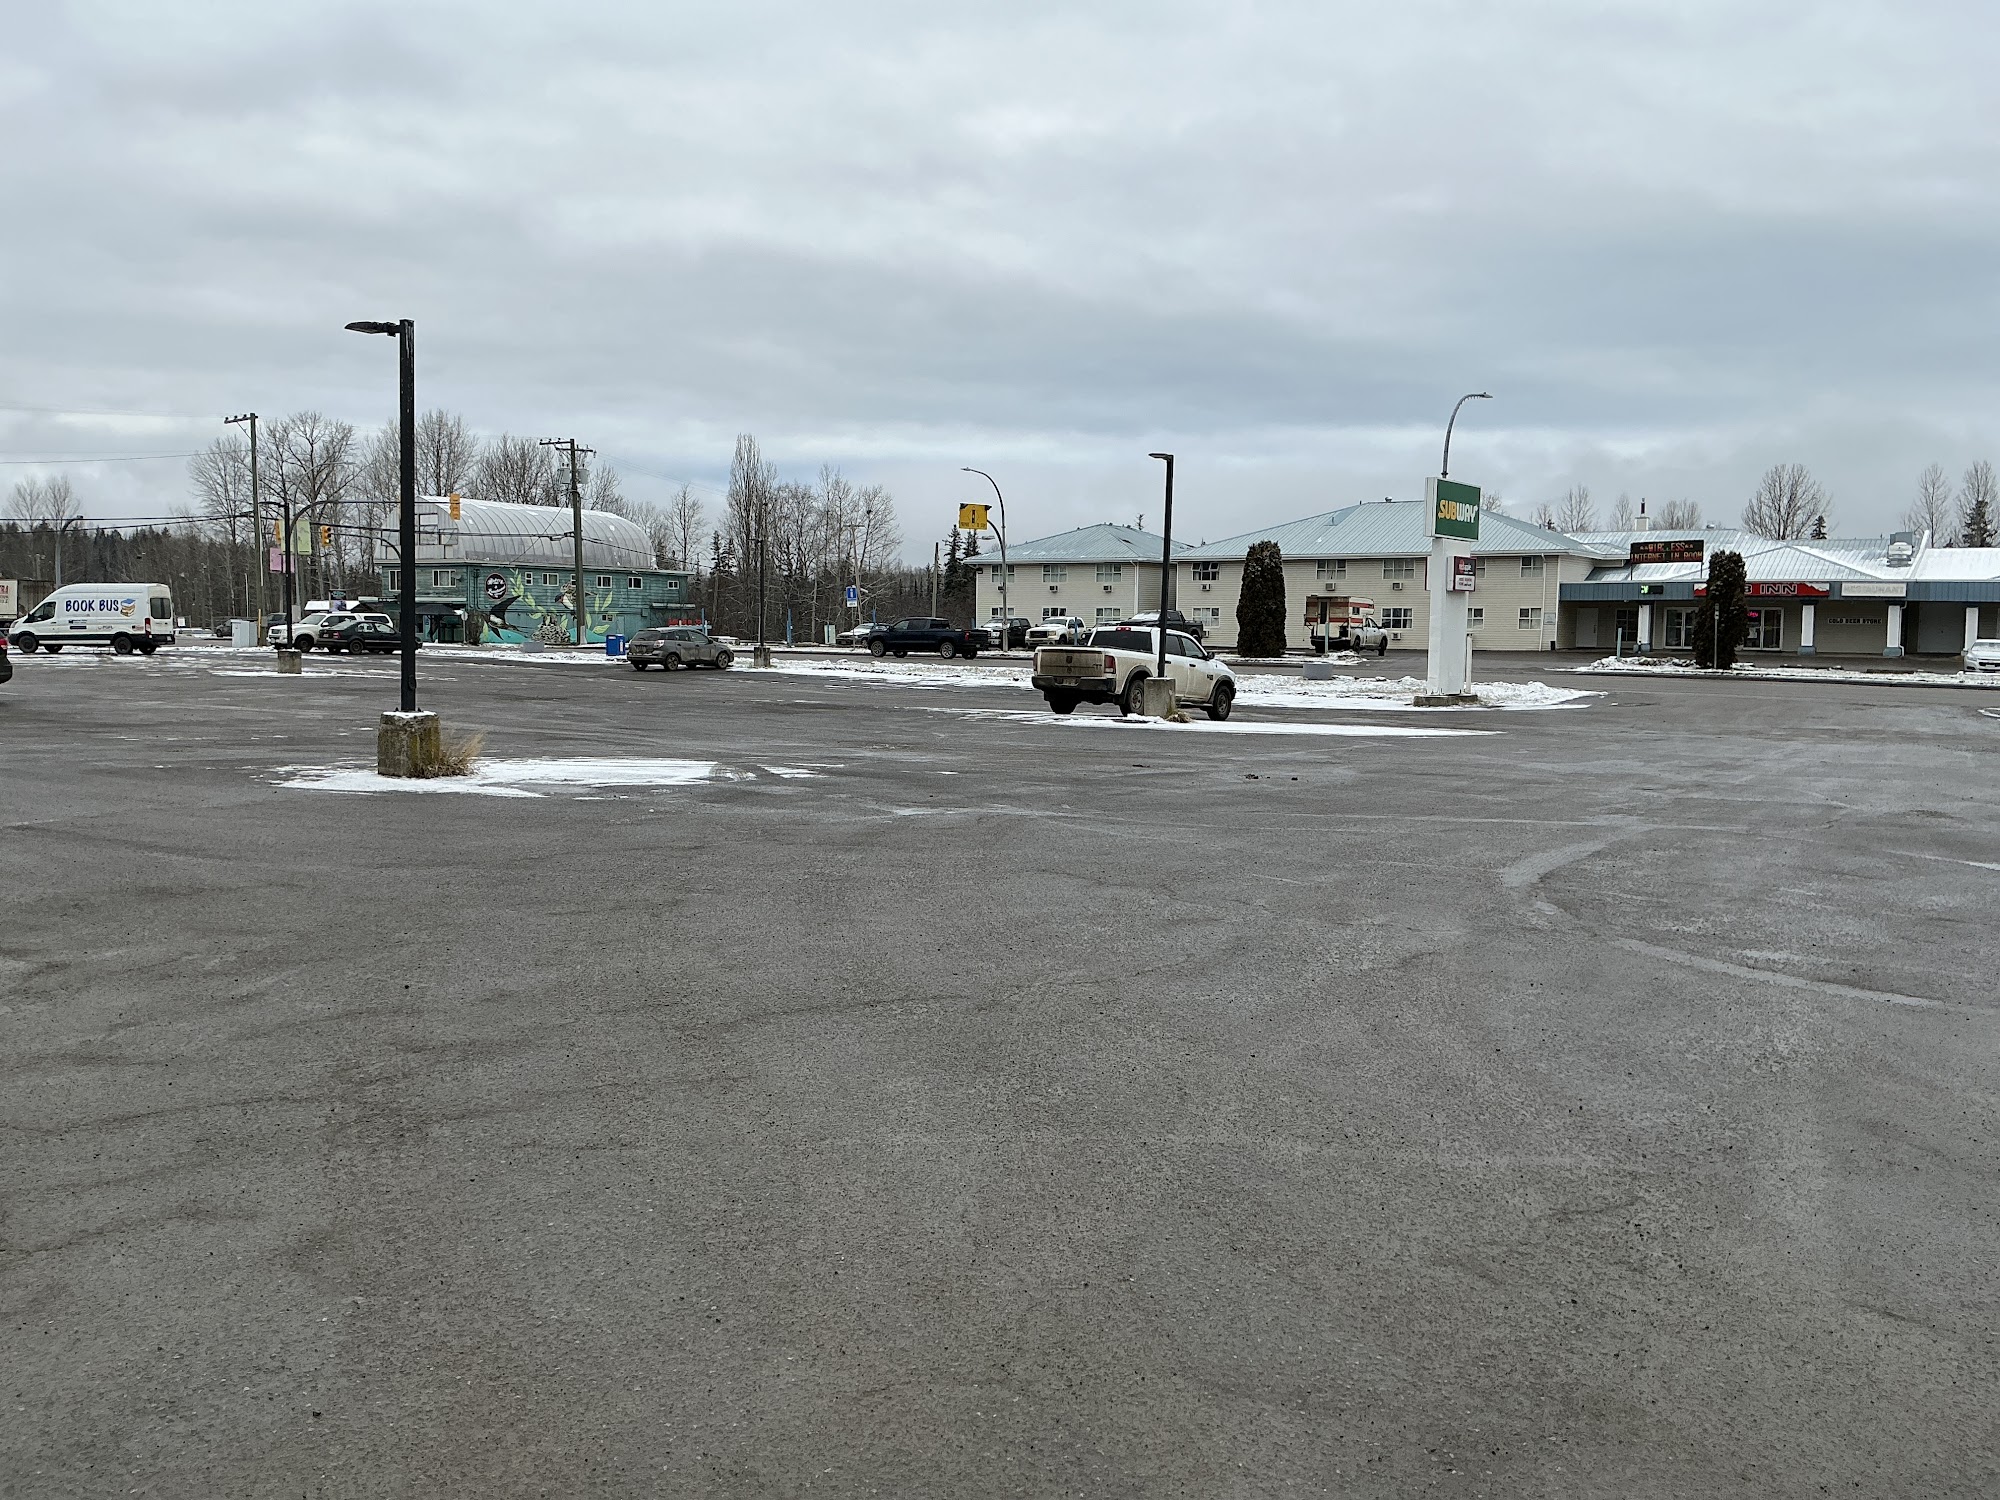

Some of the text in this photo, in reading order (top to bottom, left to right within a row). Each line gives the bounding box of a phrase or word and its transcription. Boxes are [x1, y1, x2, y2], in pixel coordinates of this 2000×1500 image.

[1438, 499, 1478, 523] SUBWAY
[1631, 550, 1702, 562] INTERNET IN ROOM
[1760, 583, 1798, 594] INN
[65, 599, 119, 612] BOOK BUS
